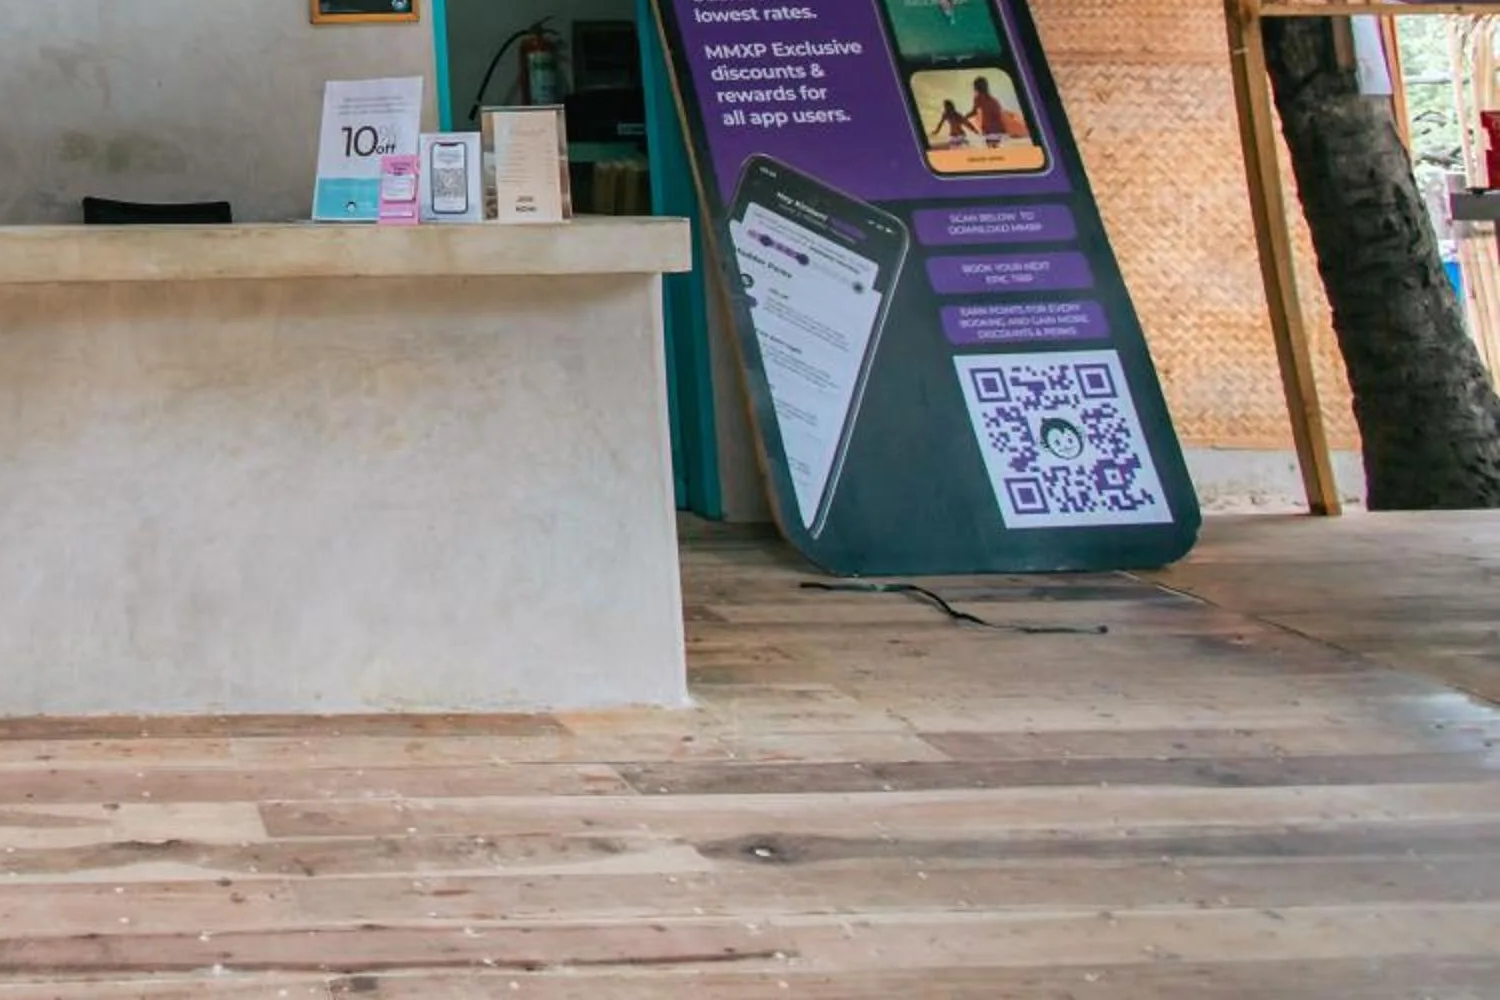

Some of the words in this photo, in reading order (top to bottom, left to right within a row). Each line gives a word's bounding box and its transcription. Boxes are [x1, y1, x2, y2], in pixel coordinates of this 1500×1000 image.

[694, 7, 760, 23] lowest
[764, 6, 817, 21] rates.
[704, 43, 767, 60] MMXP
[771, 39, 863, 57] Exclusive
[711, 64, 807, 82] discounts
[810, 63, 826, 78] &
[717, 85, 797, 103] rewards
[800, 85, 827, 101] for
[723, 110, 746, 126] all
[750, 112, 789, 128] app
[793, 109, 851, 124] users.
[376, 143, 396, 155] off
[947, 225, 1010, 235] DOWNLOAD
[961, 264, 992, 274] BOOK
[994, 263, 1023, 272] YOUR
